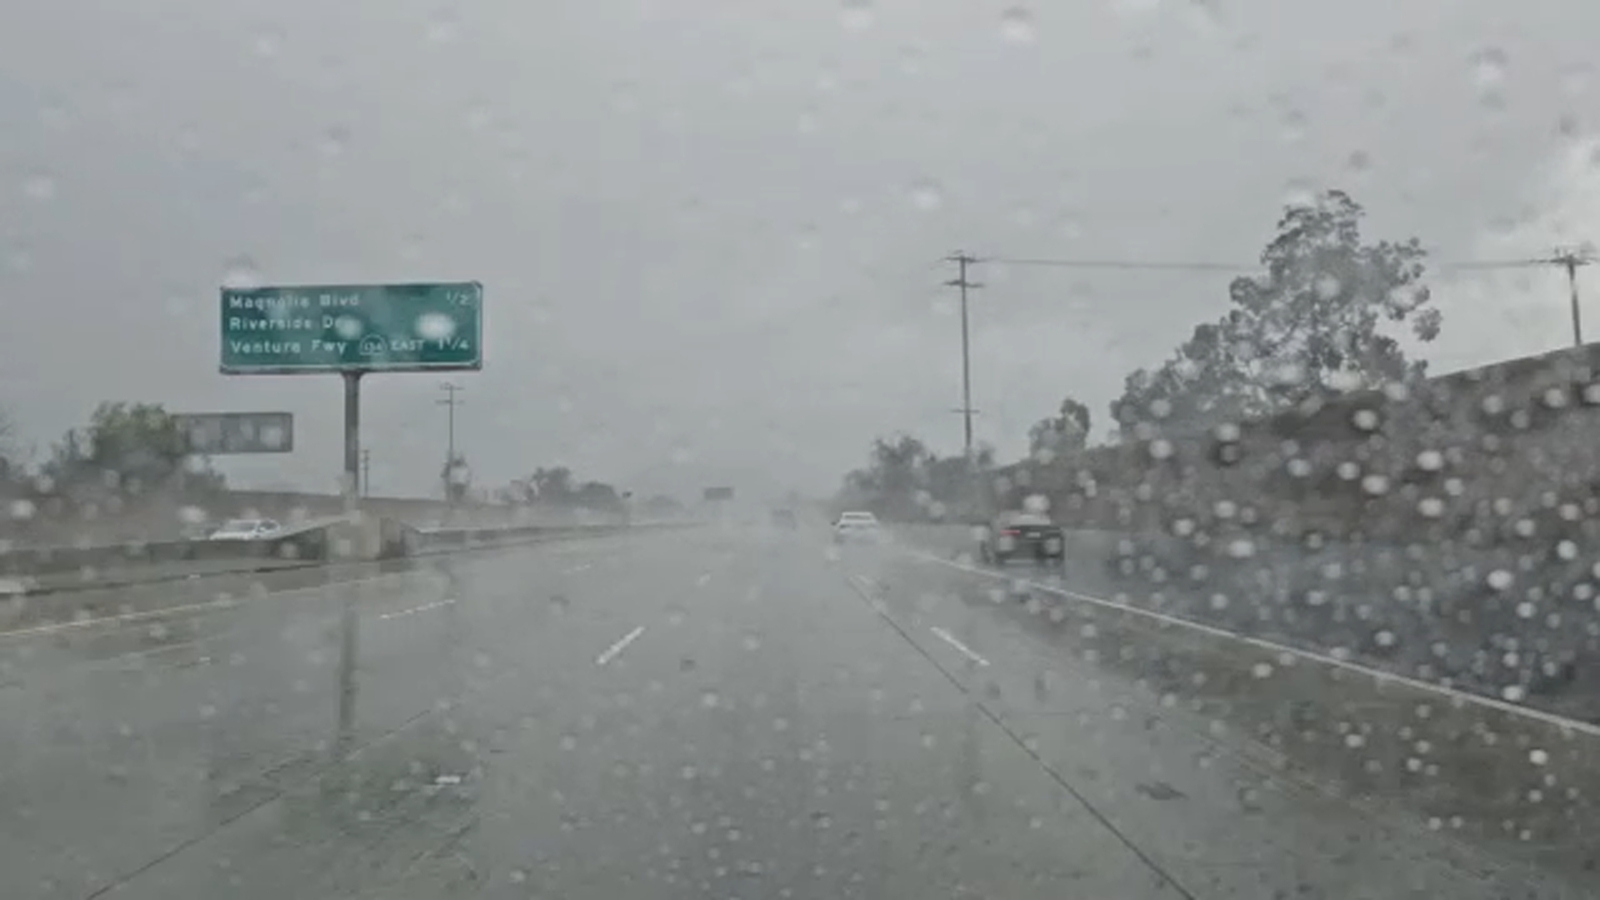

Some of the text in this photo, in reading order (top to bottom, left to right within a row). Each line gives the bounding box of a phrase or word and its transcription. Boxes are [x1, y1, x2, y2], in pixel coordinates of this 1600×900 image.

[319, 294, 359, 306] Blvd
[229, 316, 312, 331] Riverside
[311, 339, 347, 355] Fwy
[390, 340, 424, 351] EAST
